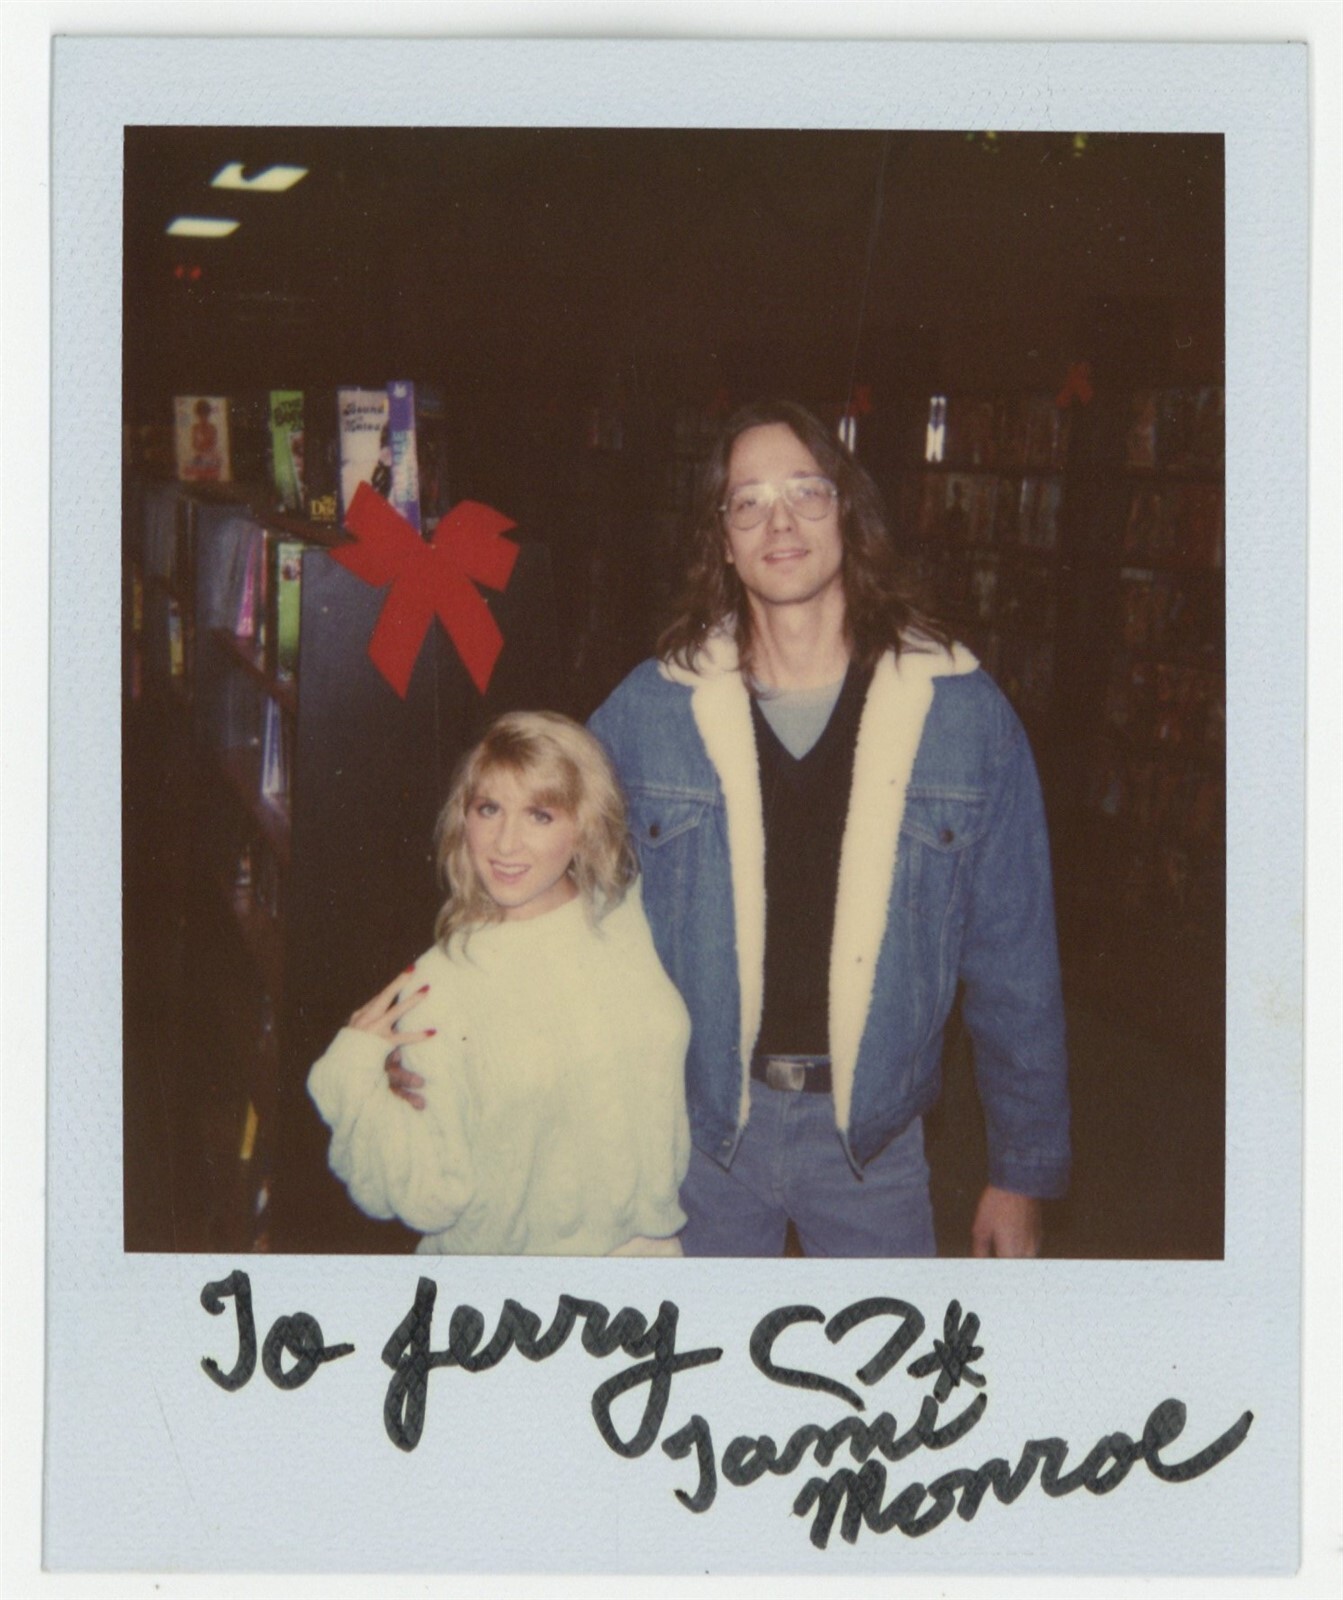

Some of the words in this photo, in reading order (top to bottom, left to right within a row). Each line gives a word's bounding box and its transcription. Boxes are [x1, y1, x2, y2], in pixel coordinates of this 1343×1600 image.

[200, 1270, 355, 1391] To
[381, 1276, 723, 1458] Jerry
[662, 1392, 987, 1513] Tami
[793, 1398, 1254, 1549] Monroe
